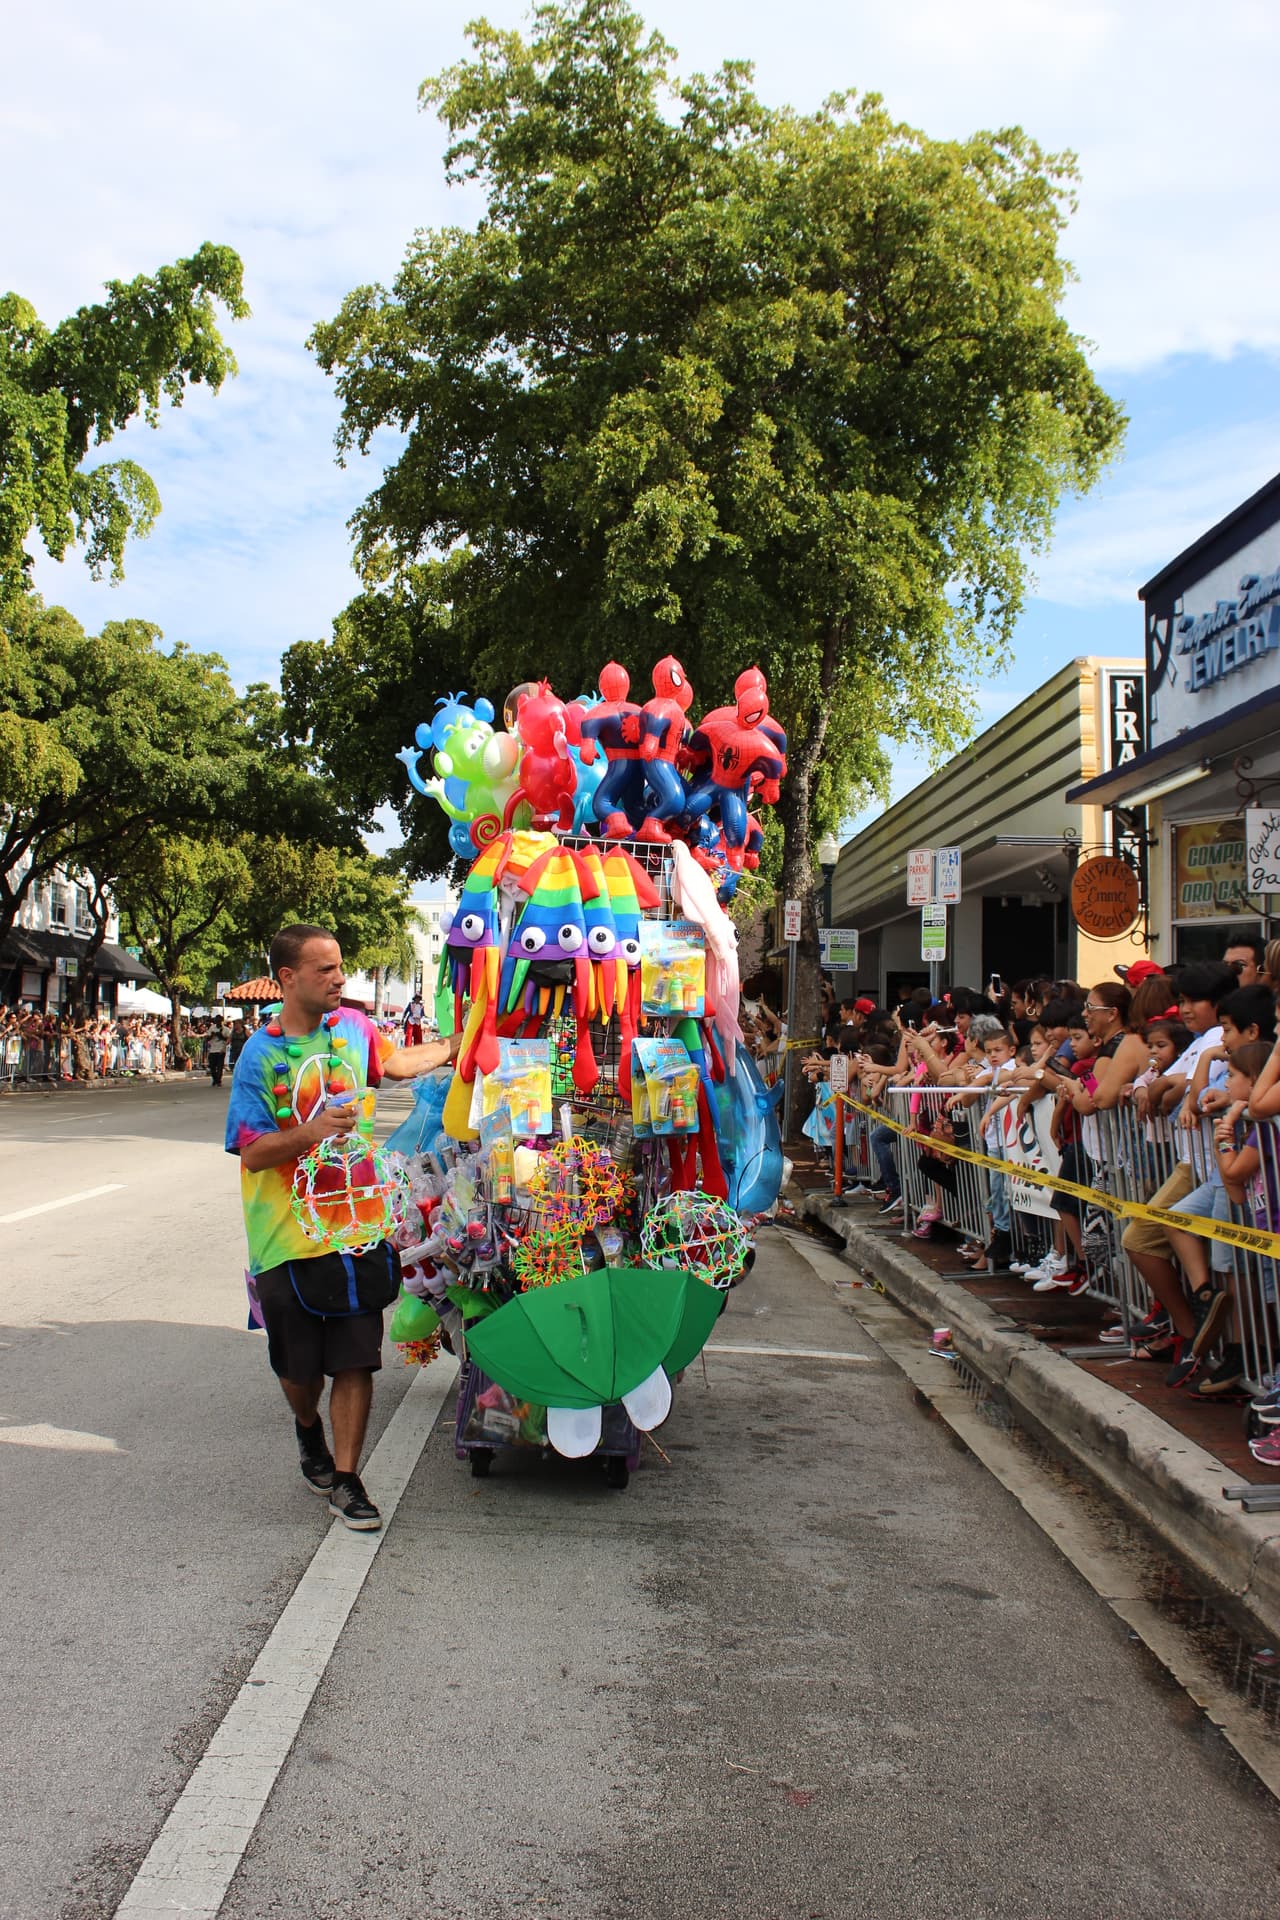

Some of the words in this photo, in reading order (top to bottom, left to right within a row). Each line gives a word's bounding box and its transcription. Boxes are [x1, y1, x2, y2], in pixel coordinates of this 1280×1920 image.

[1184, 606, 1275, 693] JEWELRY
[914, 853, 924, 864] NO
[909, 865, 929, 875] PARKING
[1075, 861, 1135, 893] Surprise
[1087, 887, 1127, 903] Emma
[1182, 881, 1213, 903] ORO
[1077, 901, 1135, 930] Jewelry
